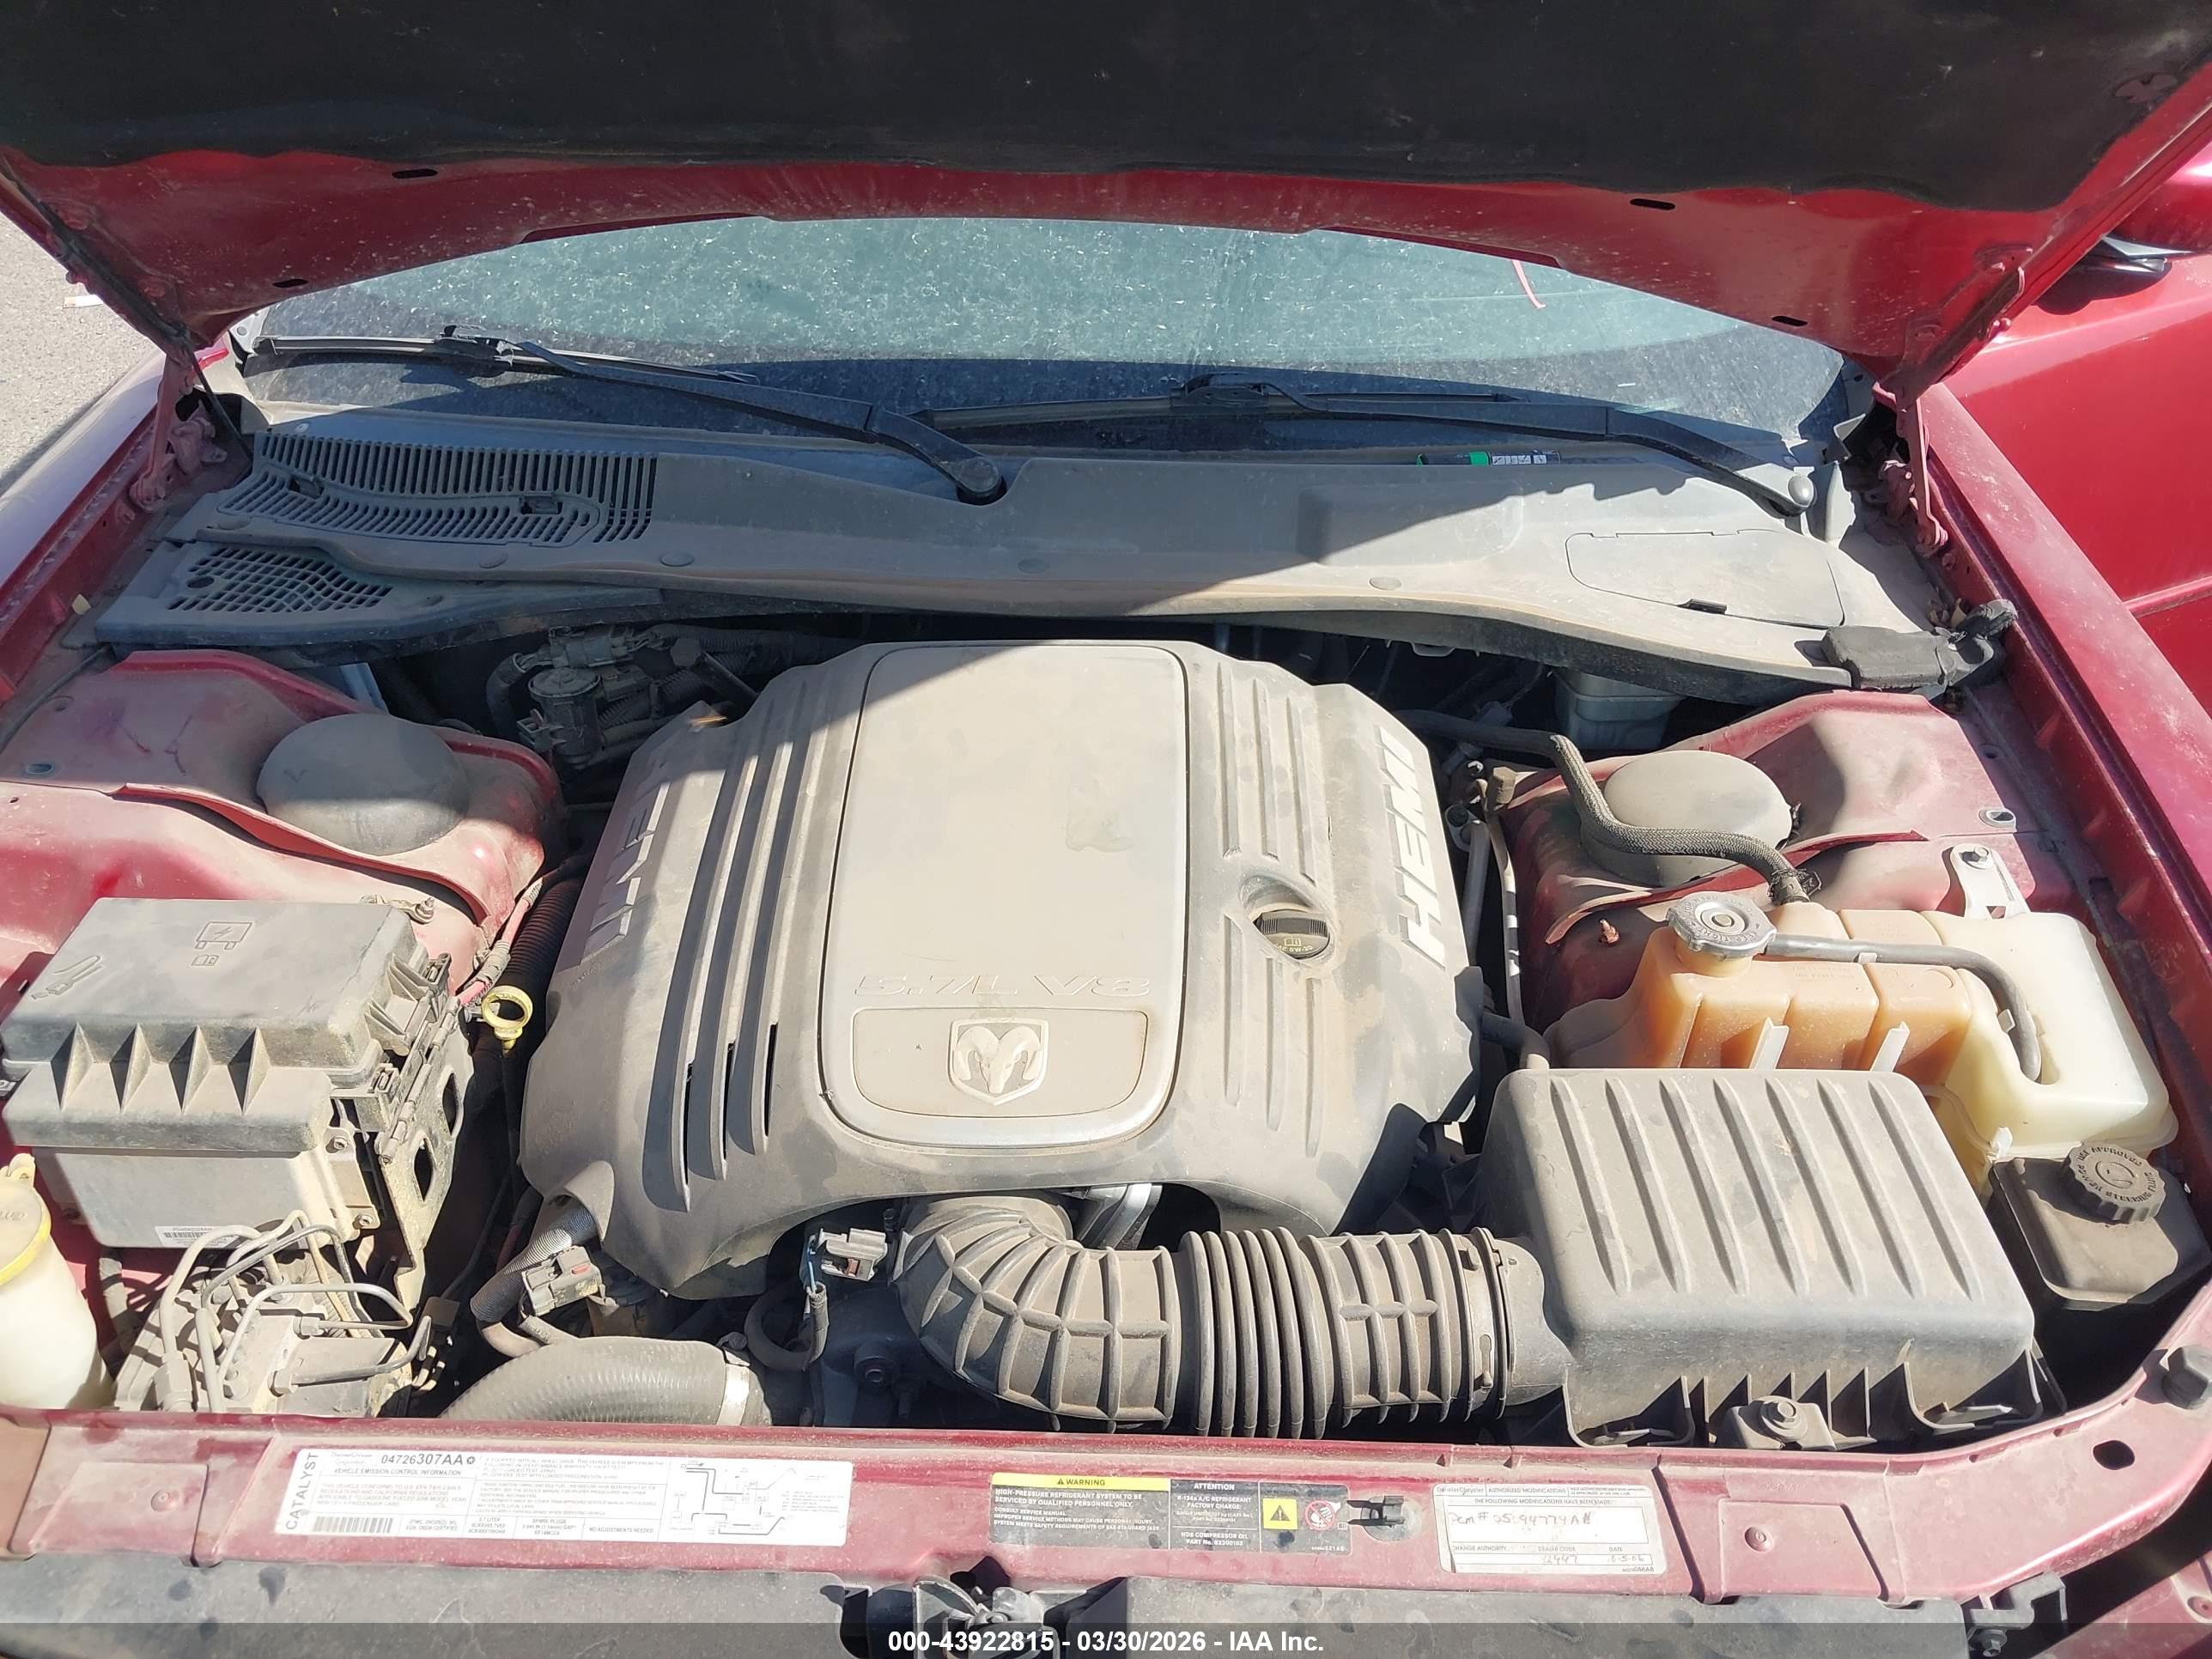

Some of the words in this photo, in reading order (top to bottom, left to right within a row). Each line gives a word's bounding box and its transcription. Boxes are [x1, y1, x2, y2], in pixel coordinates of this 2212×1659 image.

[1374, 726, 1447, 972] HEMI
[1033, 975, 1150, 997] V8
[2090, 1146, 2143, 1167] APPROVED
[380, 1453, 464, 1465] 04726307AA
[1066, 1479, 1106, 1487] WARNING
[285, 1452, 319, 1531] CATALYST
[995, 1488, 1049, 1498] HIGH-PRESSURE
[1049, 1491, 1095, 1499] REFRIGERANT
[994, 1496, 1027, 1504] SERVICED
[1037, 1498, 1073, 1507] QUALIFIED
[1073, 1499, 1114, 1508] PERSONNEL
